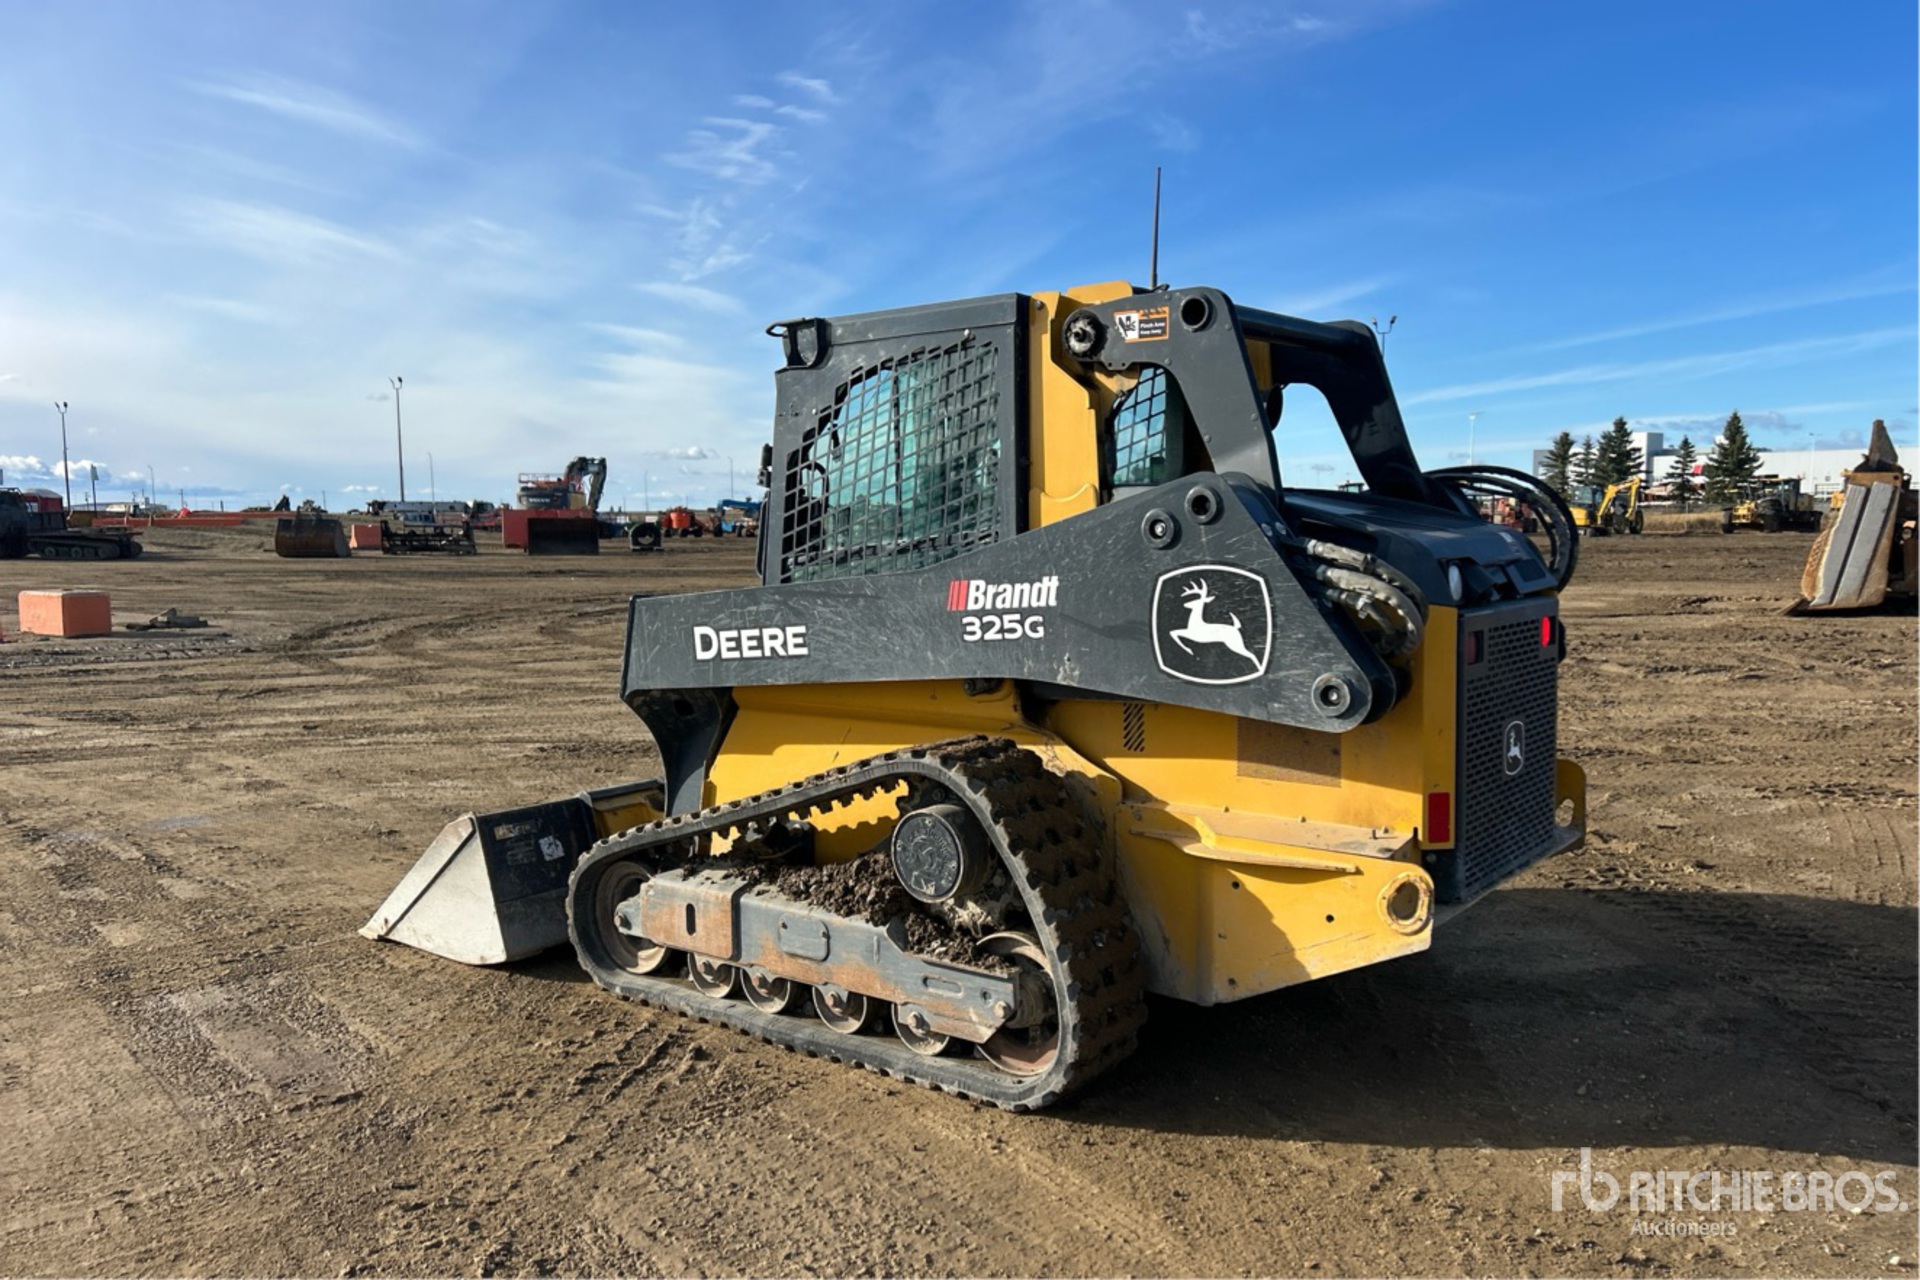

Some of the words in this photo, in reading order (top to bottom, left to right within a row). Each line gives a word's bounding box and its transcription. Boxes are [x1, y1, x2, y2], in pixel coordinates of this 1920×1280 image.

[967, 575, 1059, 611] Brandt
[693, 625, 809, 661] DEERE
[961, 613, 1046, 642] 325G
